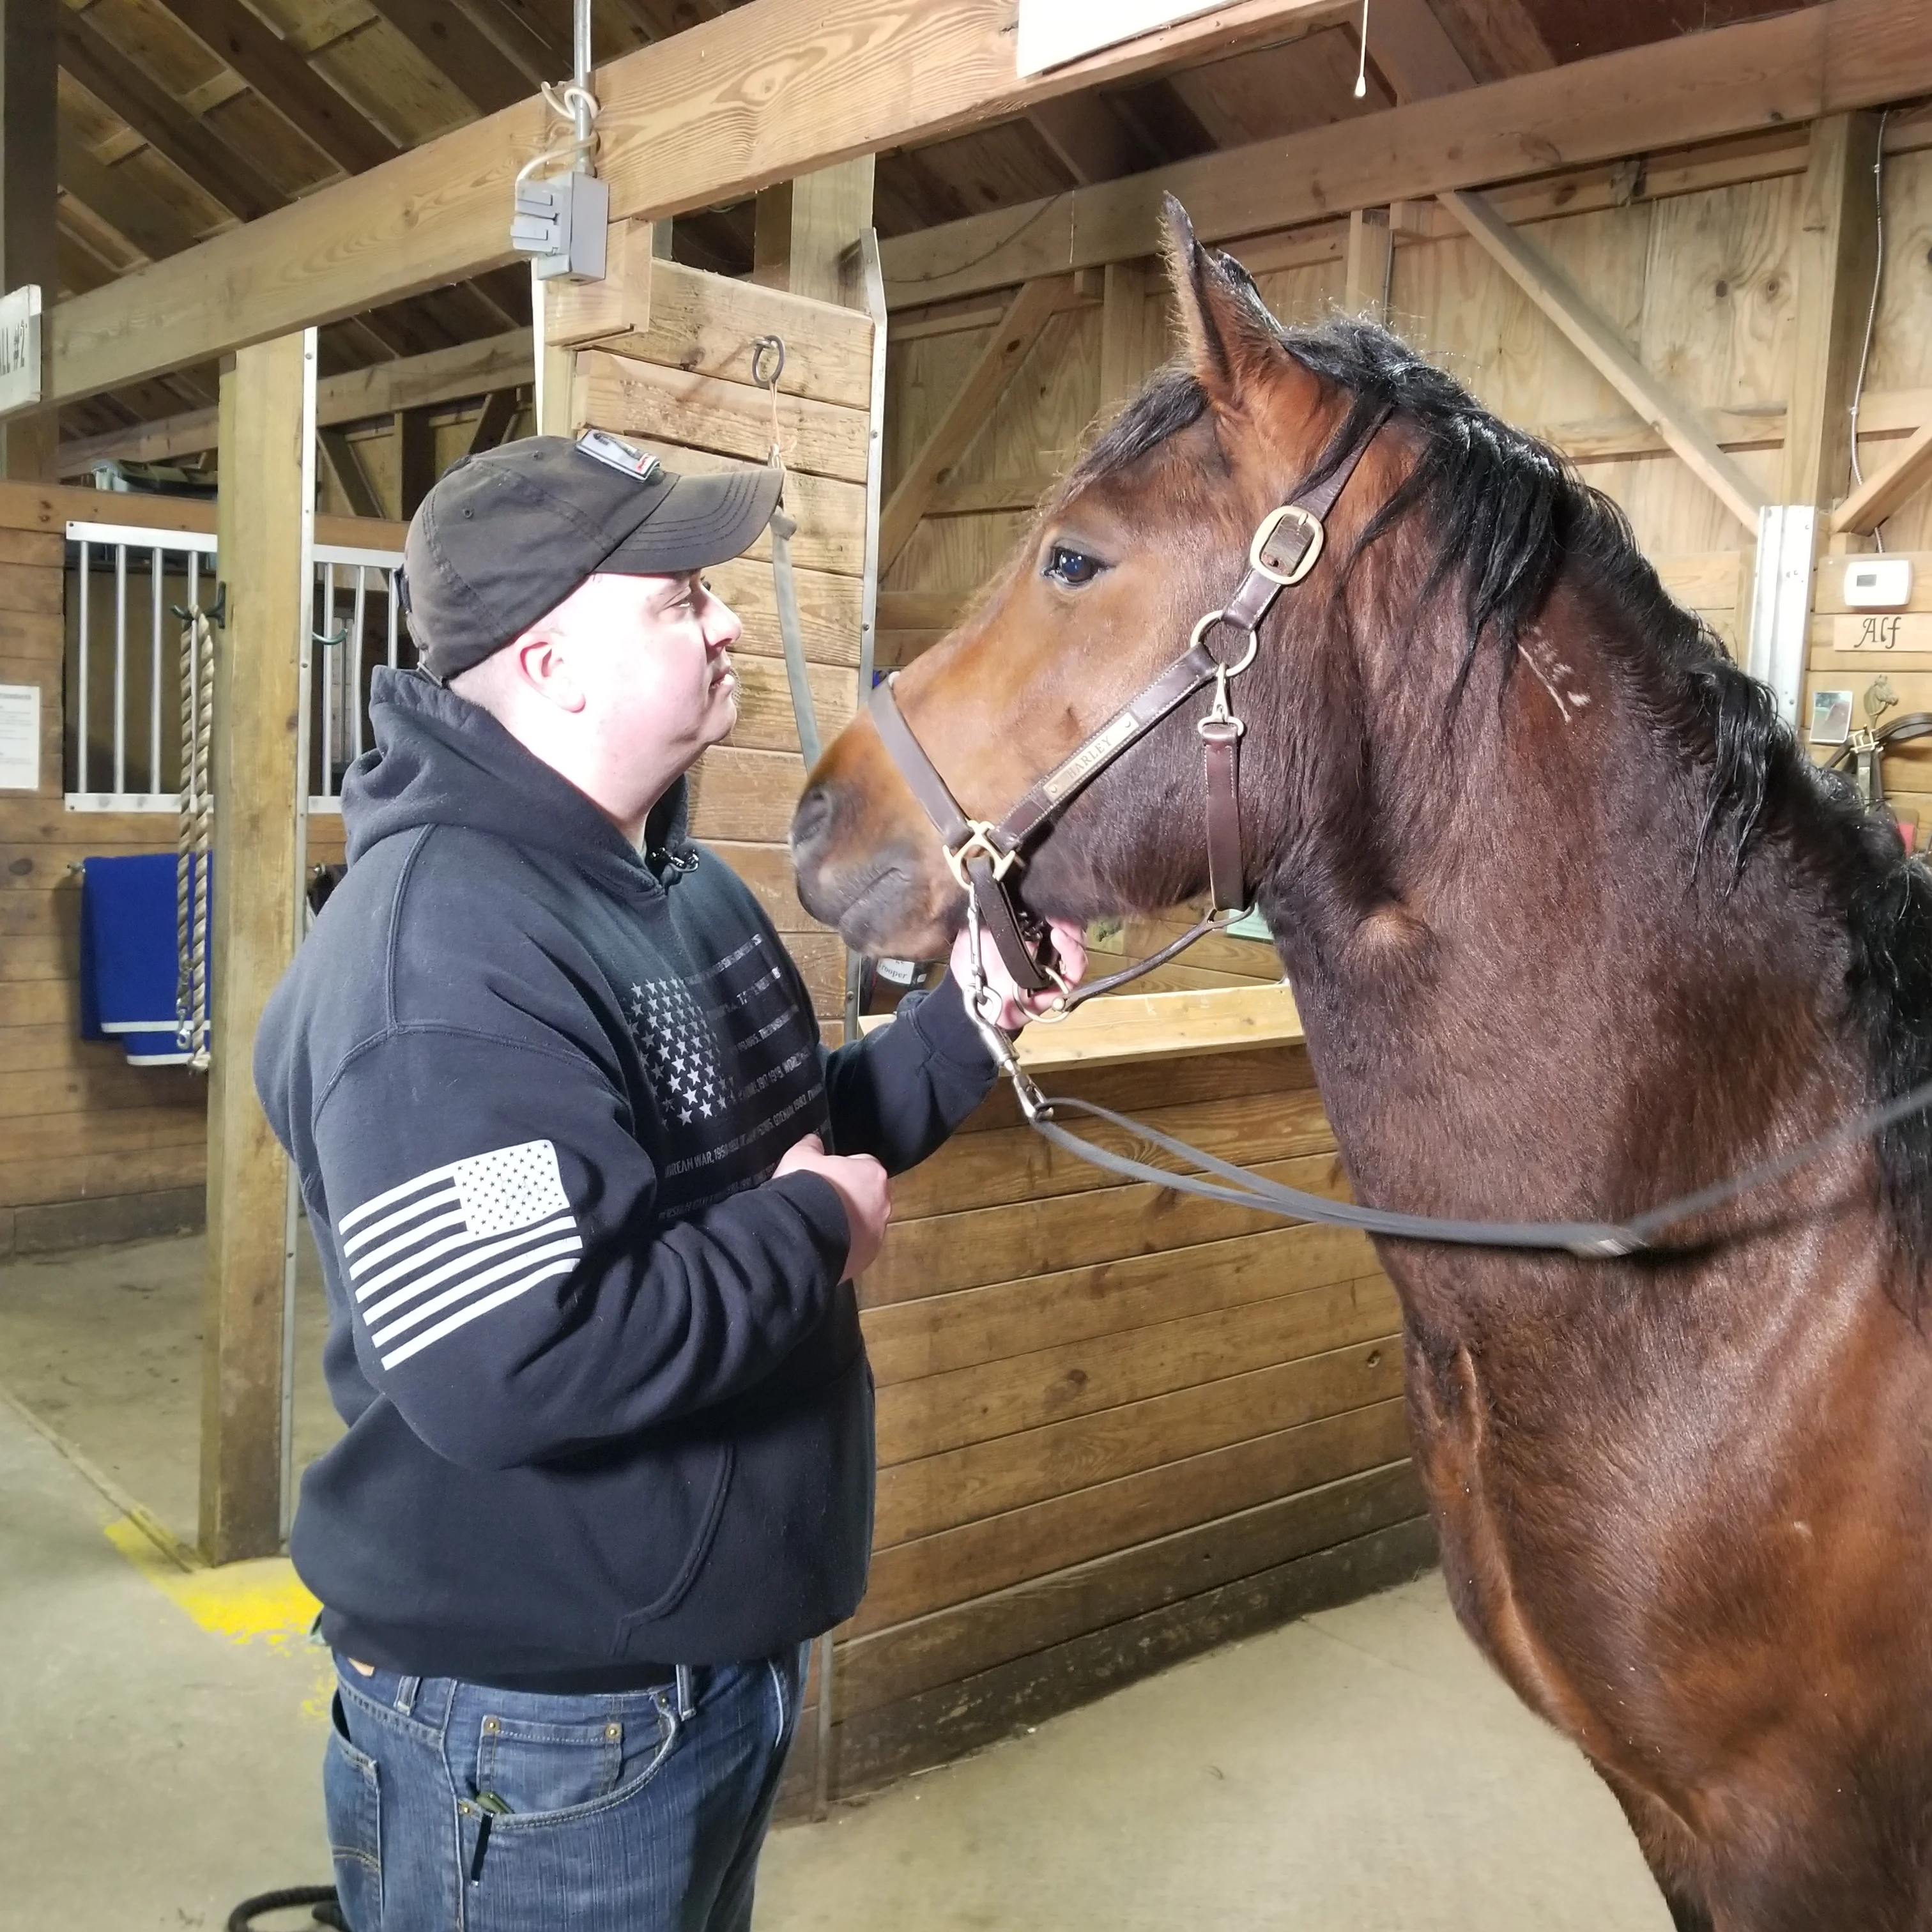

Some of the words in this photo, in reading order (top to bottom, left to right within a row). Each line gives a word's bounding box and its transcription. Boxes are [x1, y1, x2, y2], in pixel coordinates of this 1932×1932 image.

[1853, 616, 1901, 649] Alf
[1066, 735, 1112, 779] HARLEY
[694, 1151, 714, 1169] WAR,
